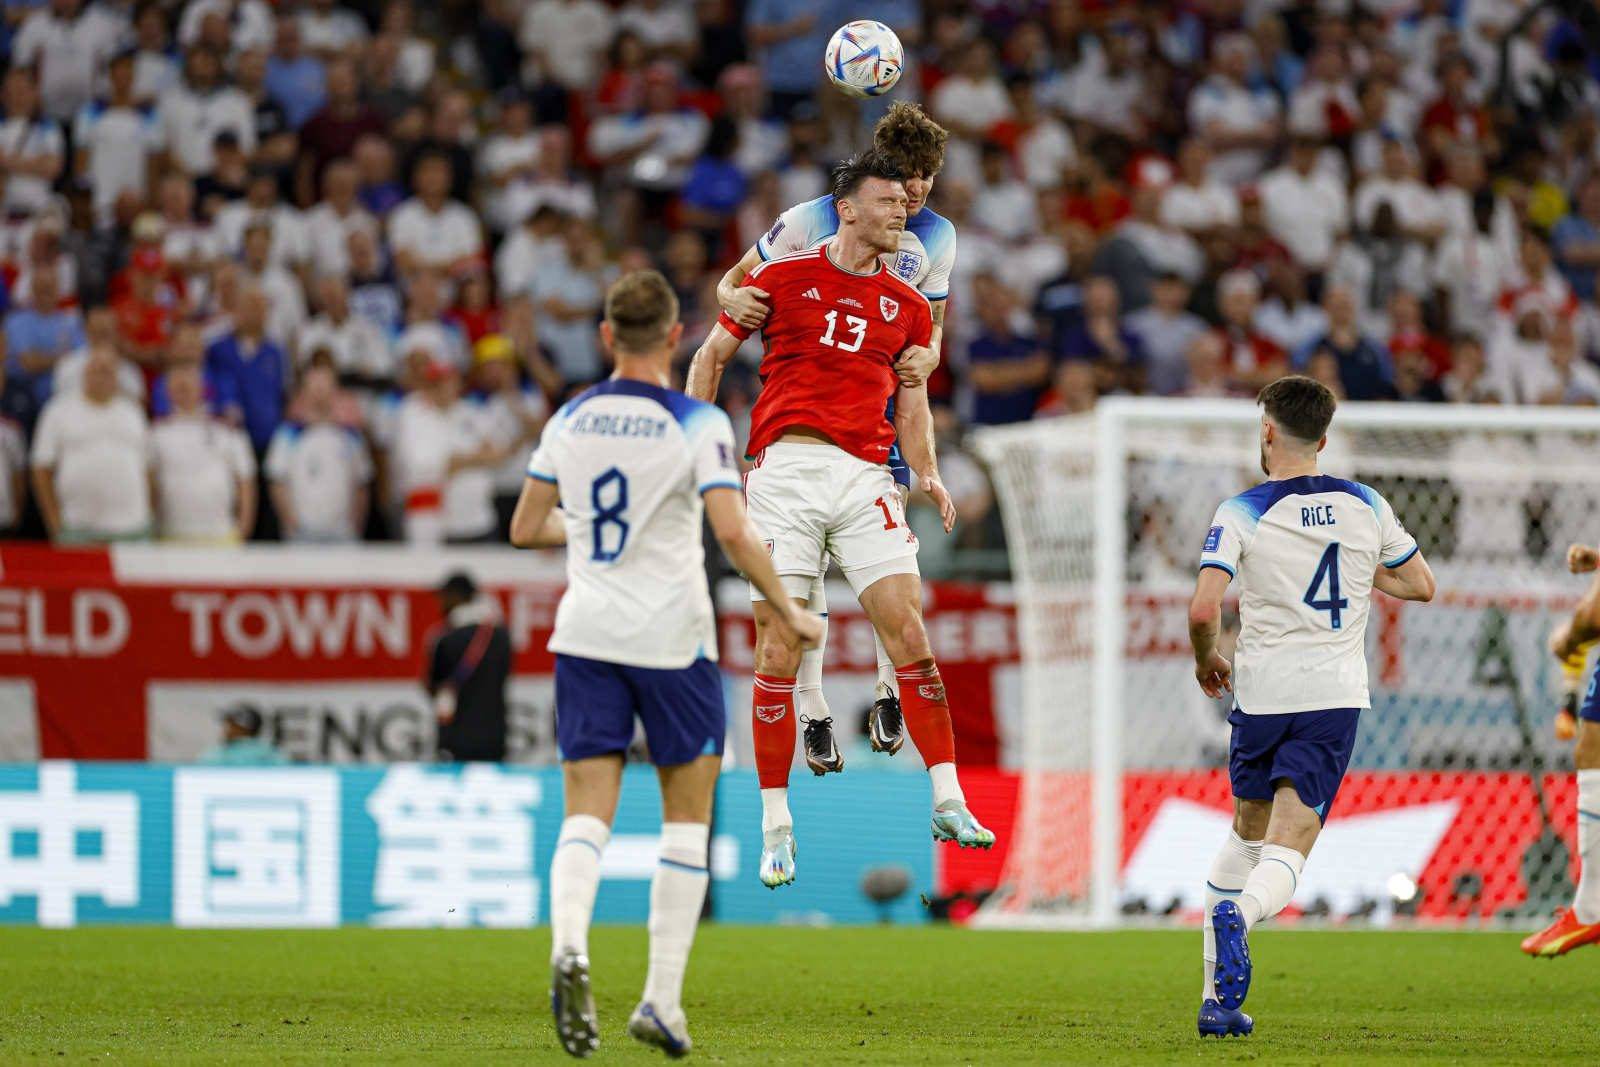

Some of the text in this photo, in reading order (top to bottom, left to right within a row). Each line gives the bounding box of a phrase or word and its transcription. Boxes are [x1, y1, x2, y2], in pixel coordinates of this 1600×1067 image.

[819, 309, 868, 353] 13
[590, 465, 630, 564] 8
[172, 591, 411, 659] TOWN
[1302, 541, 1349, 632] 4
